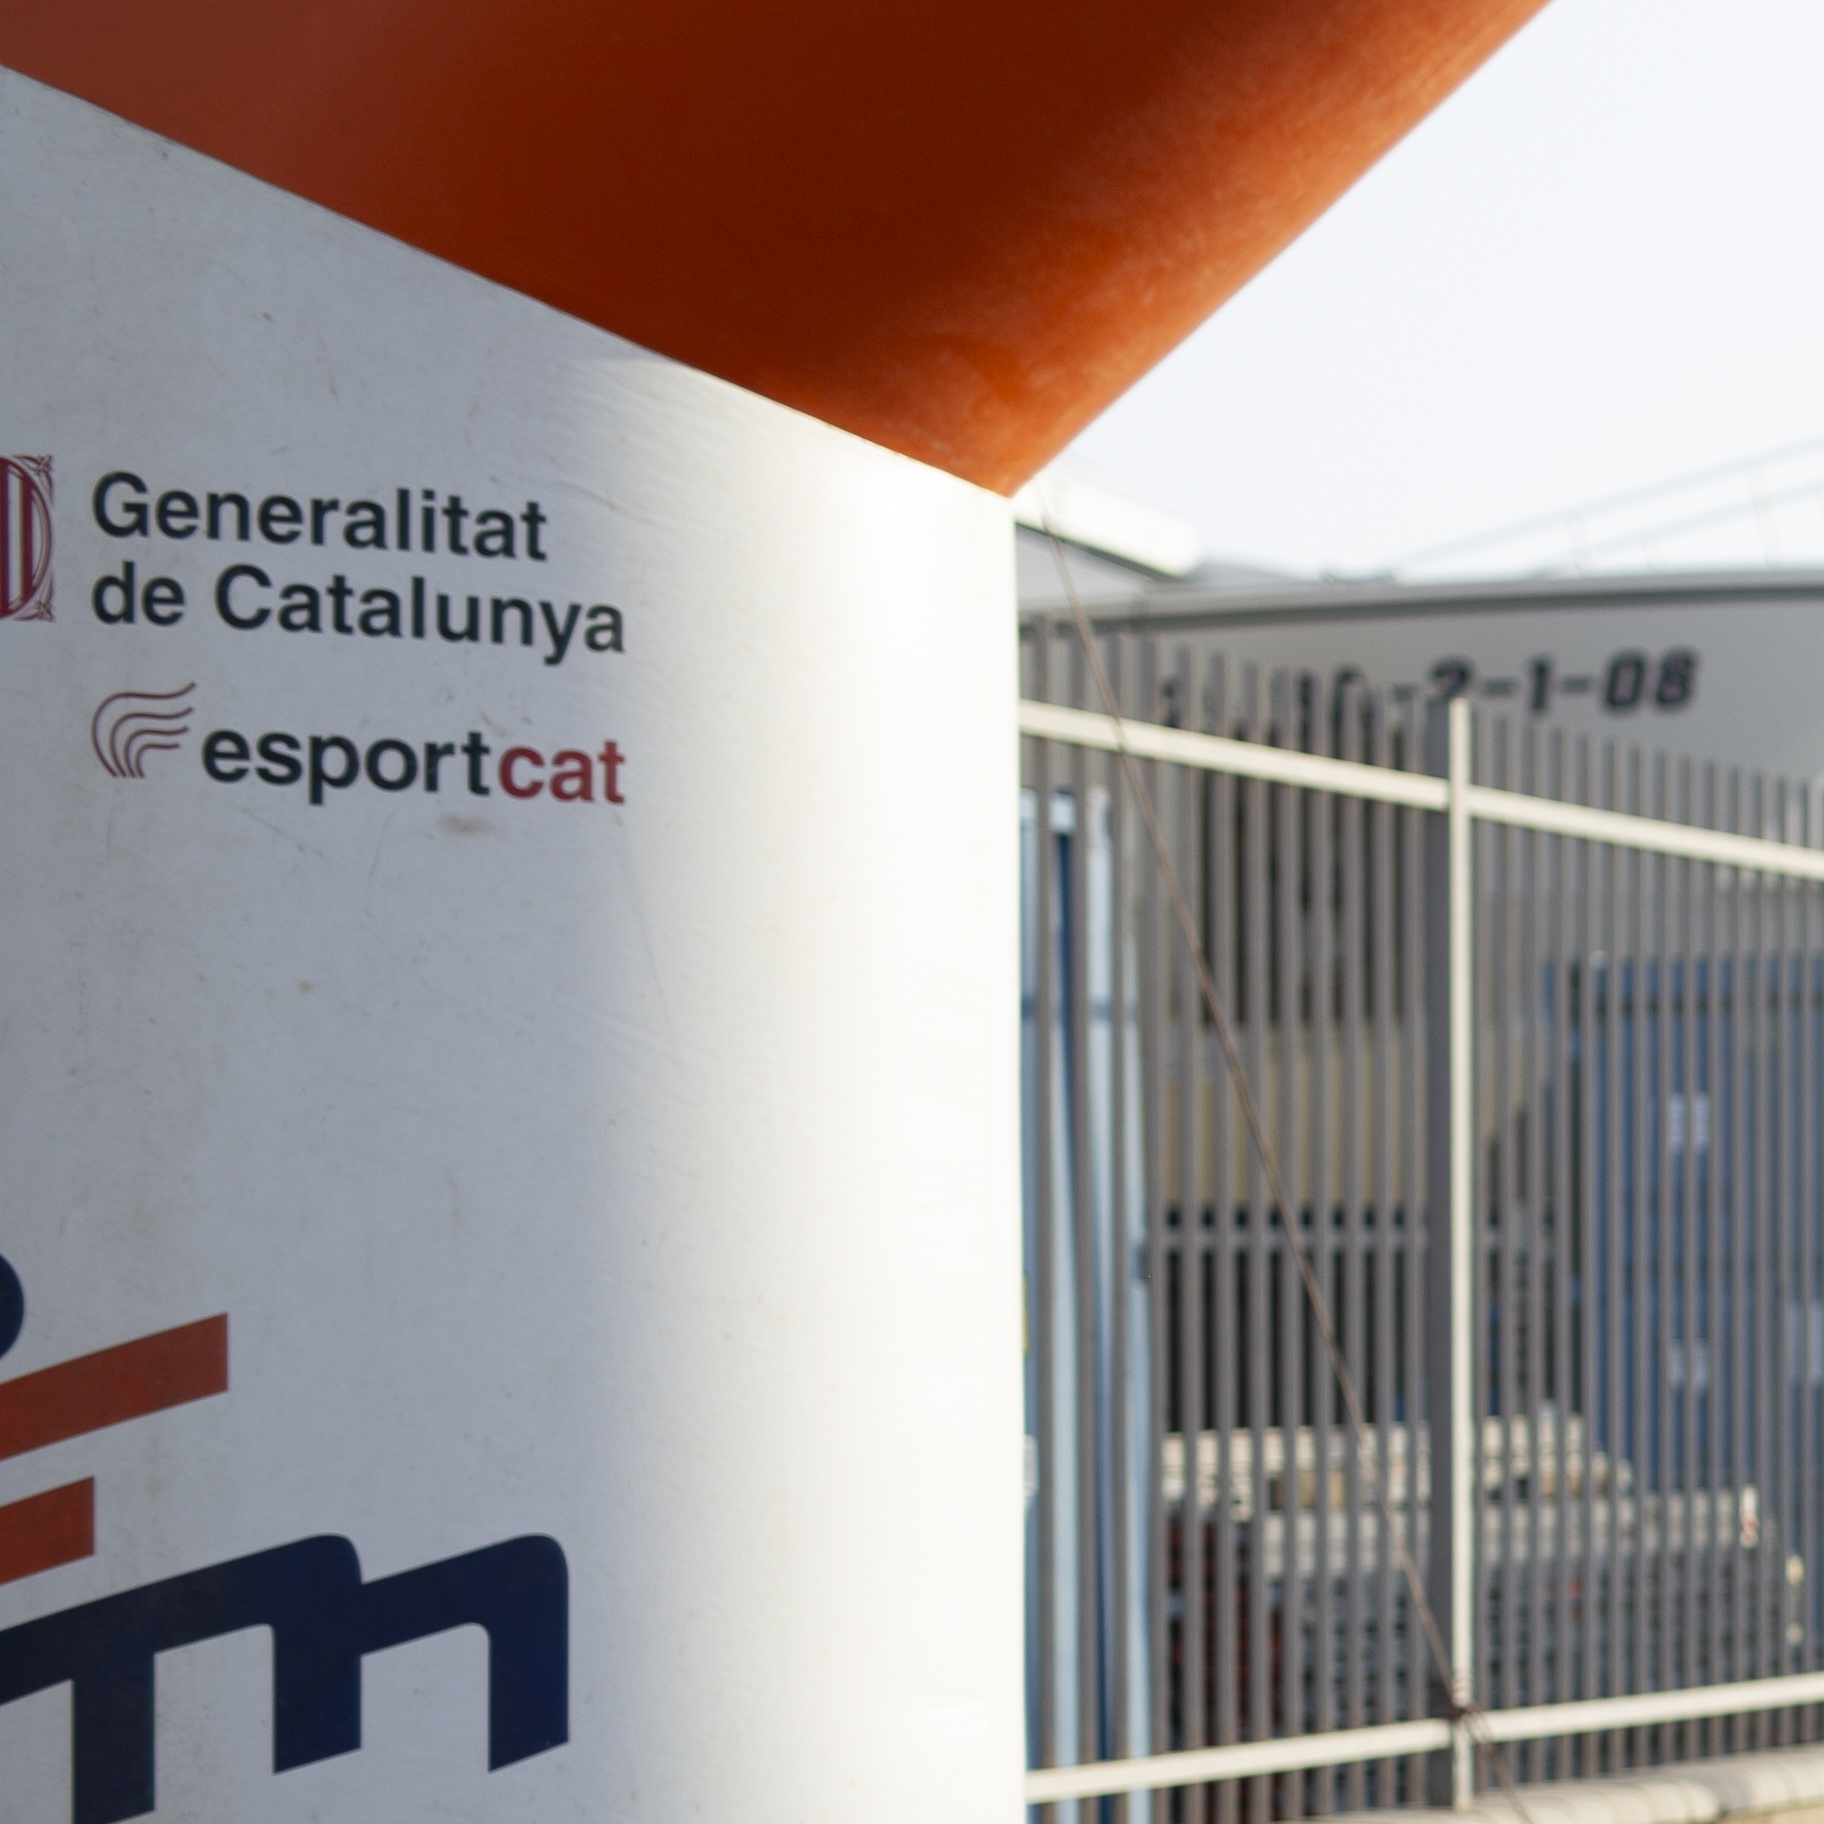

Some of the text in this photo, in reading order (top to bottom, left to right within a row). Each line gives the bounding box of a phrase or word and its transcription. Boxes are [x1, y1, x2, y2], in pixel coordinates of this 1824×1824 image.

[90, 470, 548, 561] Generalitat
[92, 561, 627, 666] de Catalunya
[202, 728, 627, 805] esportcat
